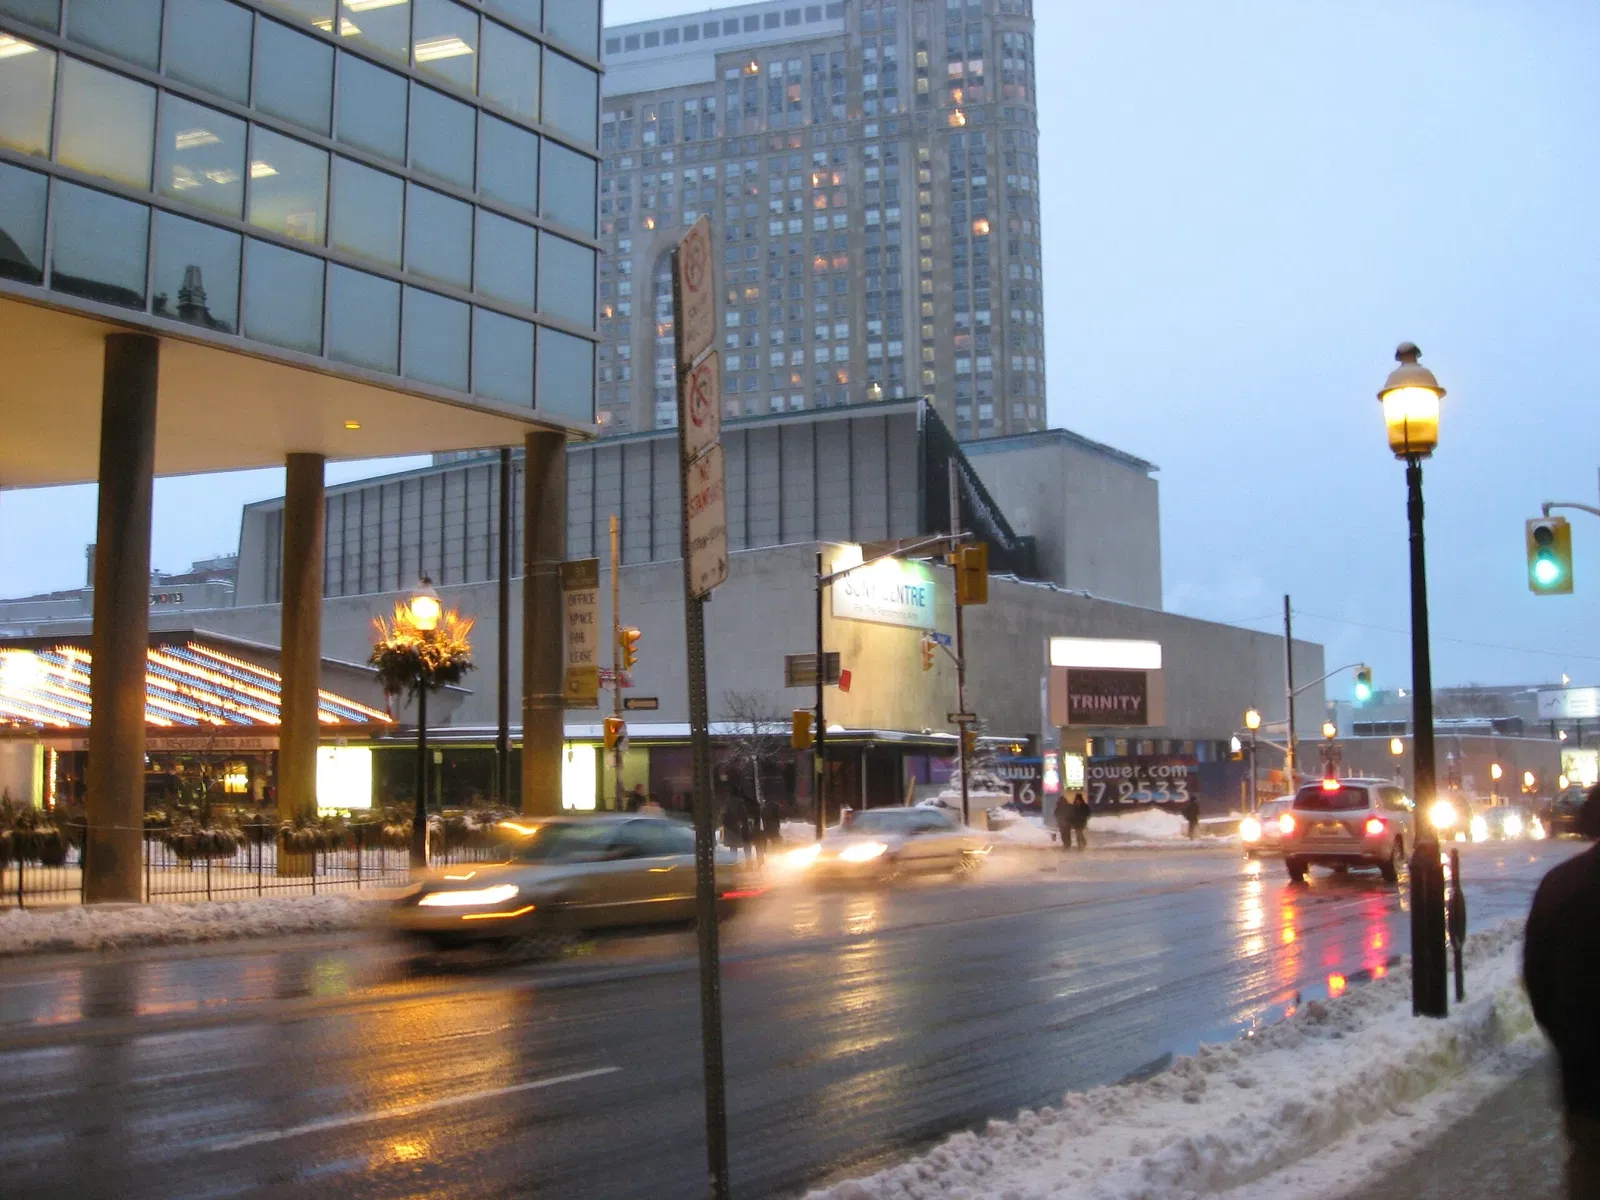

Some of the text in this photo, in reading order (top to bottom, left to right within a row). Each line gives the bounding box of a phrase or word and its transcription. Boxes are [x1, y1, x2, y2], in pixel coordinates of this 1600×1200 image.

[567, 592, 596, 606] OFFICE
[569, 611, 594, 625] SPACE
[569, 631, 585, 644] FOR
[1070, 694, 1141, 710] TRINITY
